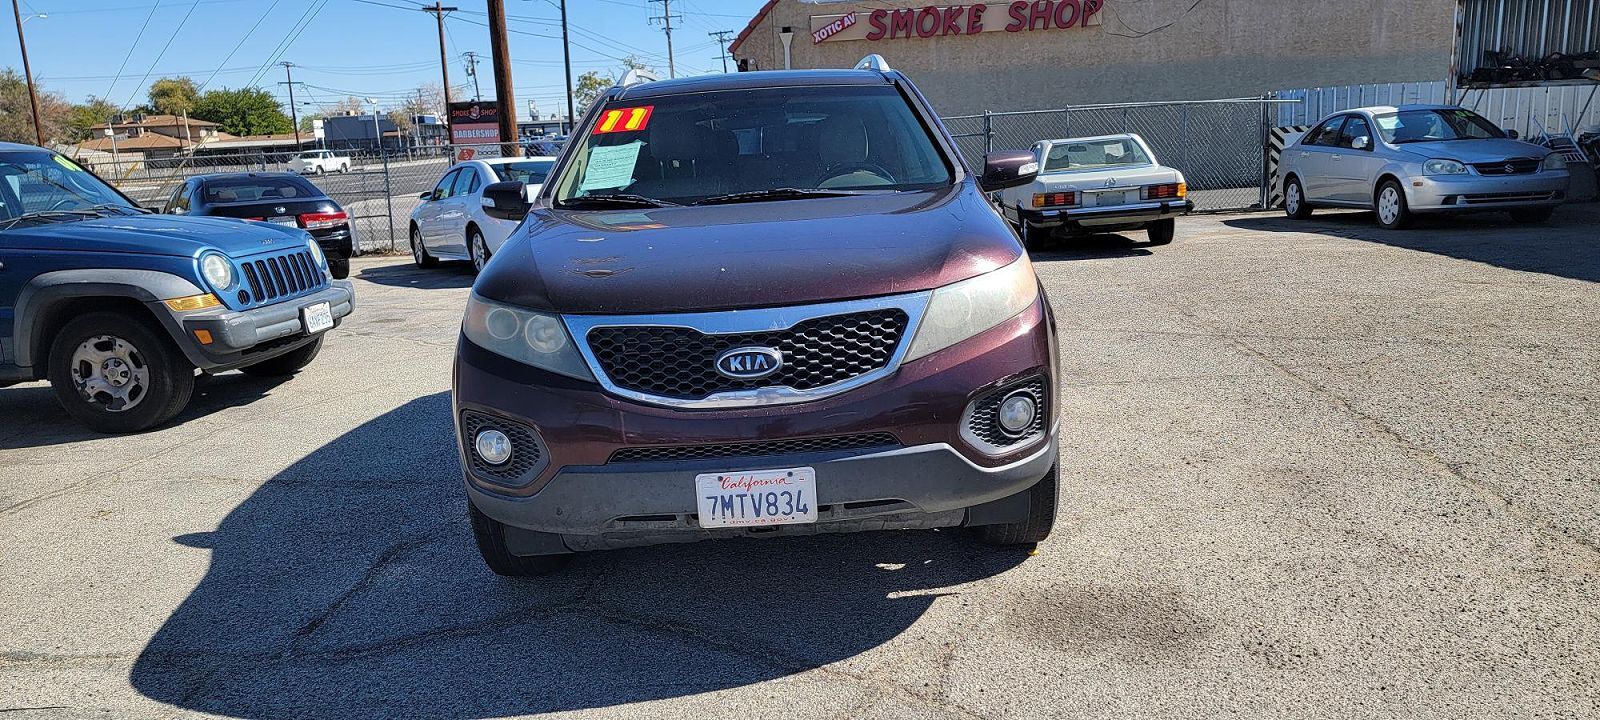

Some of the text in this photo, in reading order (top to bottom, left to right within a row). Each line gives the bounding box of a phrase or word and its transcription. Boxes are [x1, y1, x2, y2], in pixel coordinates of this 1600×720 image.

[866, 0, 1103, 41] SMOKE SHOP
[813, 20, 843, 43] XOTIC
[452, 108, 497, 117] SMOKE SHOP
[600, 107, 648, 132] 11
[453, 128, 499, 139] BARBERSHOP
[729, 354, 769, 372] KIA
[720, 475, 793, 491] California
[706, 490, 809, 520] 7MTV834
